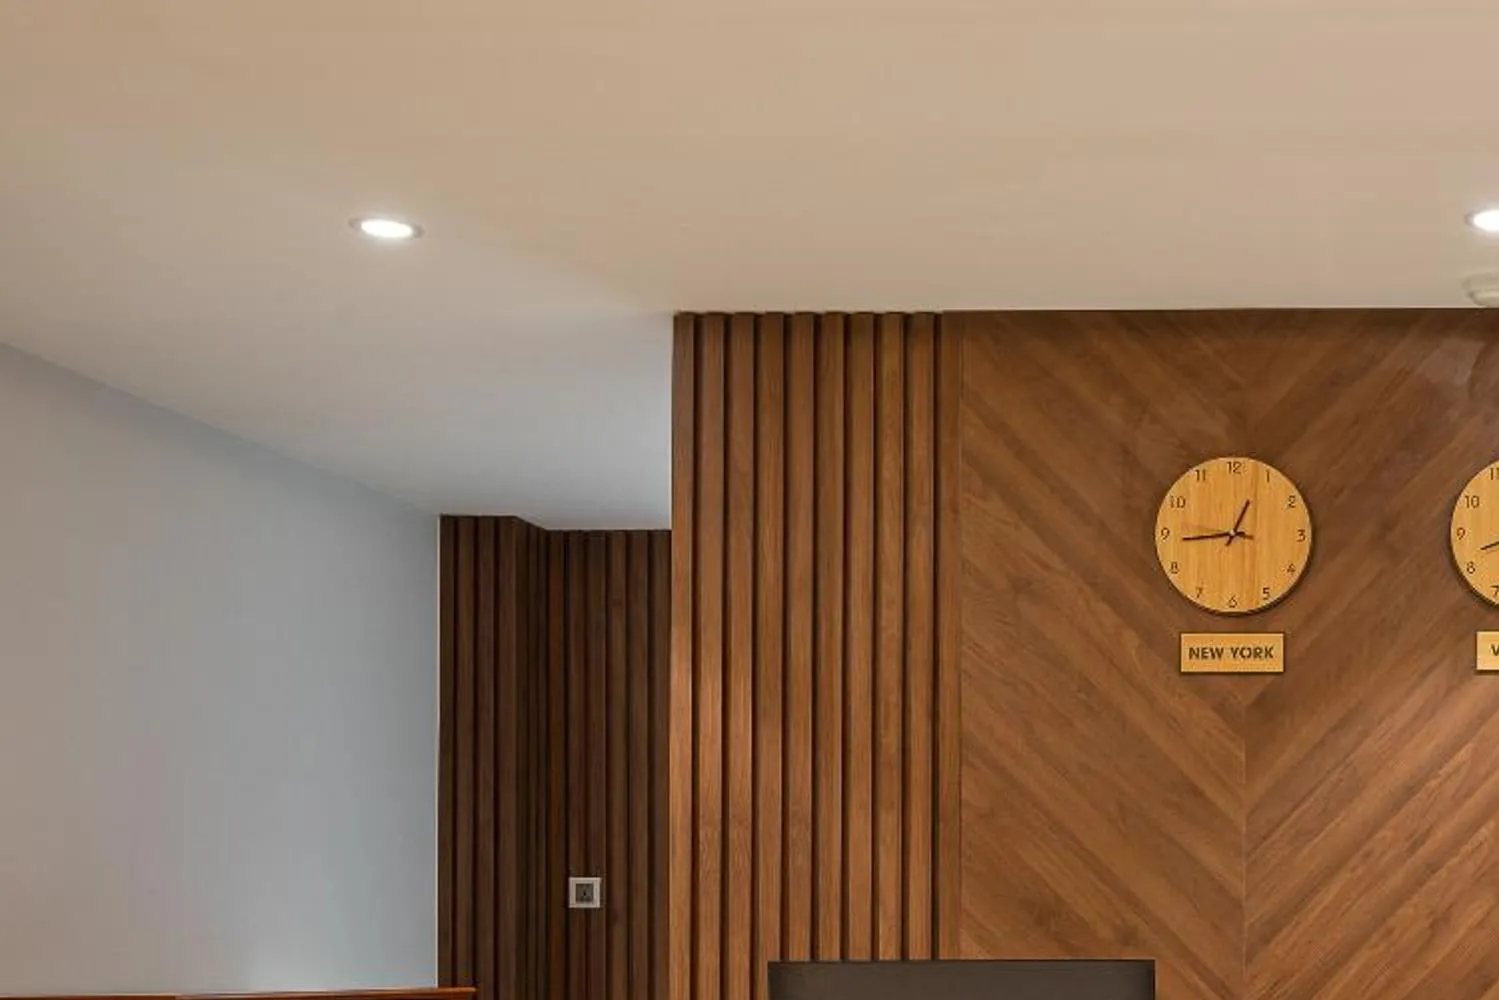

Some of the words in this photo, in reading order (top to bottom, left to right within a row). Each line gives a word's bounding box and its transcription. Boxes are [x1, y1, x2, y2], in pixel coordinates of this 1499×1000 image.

[1227, 461, 1242, 474] 12
[1195, 469, 1206, 481] 11
[1266, 470, 1271, 483] 1
[1170, 496, 1186, 509] 10
[1286, 495, 1296, 509] 2
[1465, 496, 1480, 508] 10
[1161, 527, 1170, 540] 9
[1297, 529, 1306, 542] 3
[1457, 527, 1466, 540] 9
[1170, 561, 1180, 575] 8
[1286, 563, 1296, 574] 4
[1466, 562, 1476, 574] 8
[1262, 587, 1271, 600] 5
[1491, 585, 1499, 598] 7
[1227, 596, 1238, 609] 6
[1189, 646, 1224, 660] NEW
[1230, 646, 1274, 660] YORK
